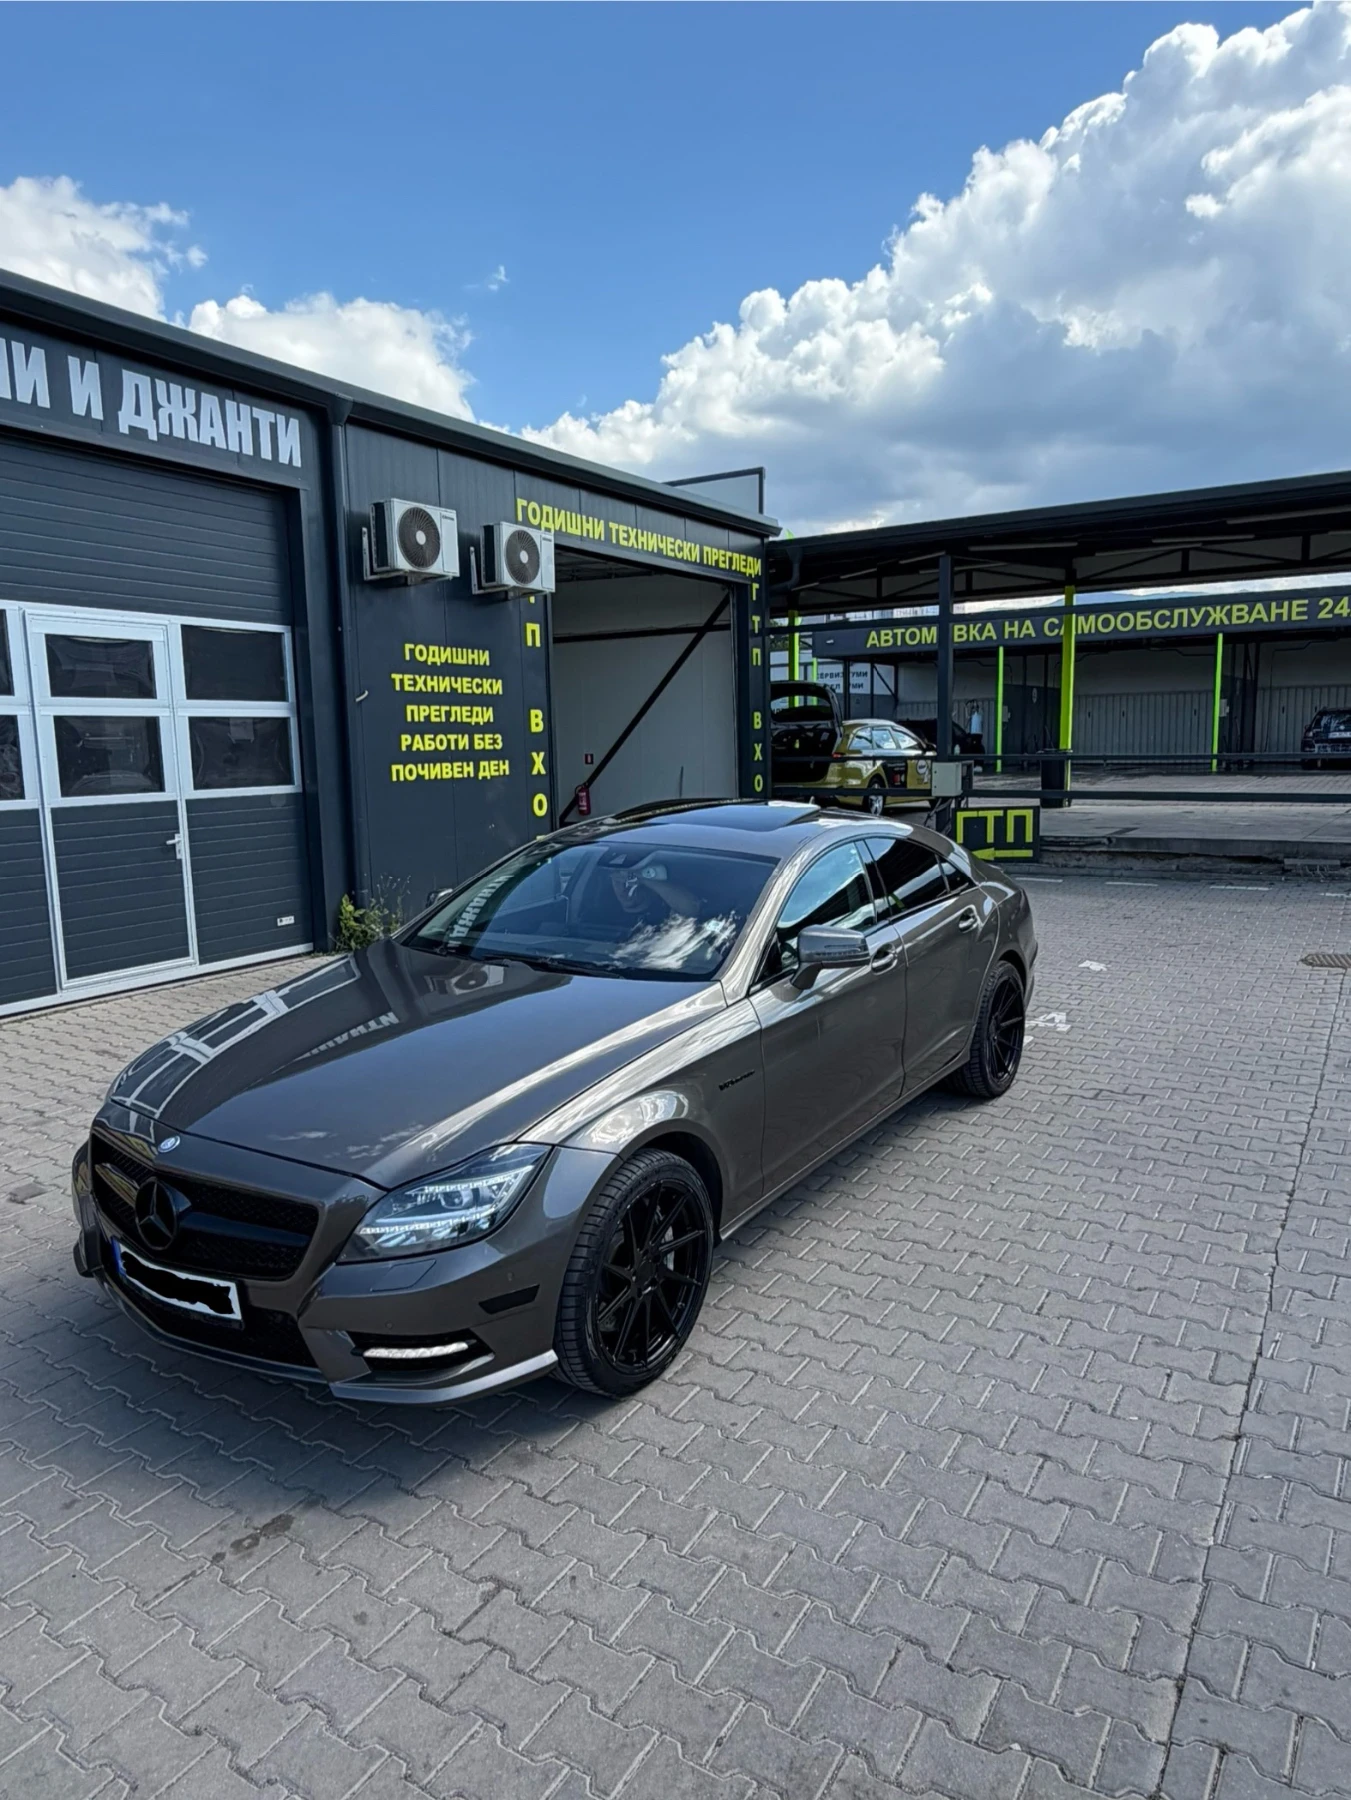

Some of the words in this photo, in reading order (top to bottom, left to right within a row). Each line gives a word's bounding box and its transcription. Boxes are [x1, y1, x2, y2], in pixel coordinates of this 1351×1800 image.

[67, 355, 104, 420] И
[118, 369, 302, 468] ДЖАНТИ
[516, 498, 605, 541] ГОДИШНИ
[608, 522, 700, 563] ТЕХНИЧЕСКИ
[703, 546, 762, 578] ПРЕГЛЕДИ
[866, 622, 997, 648] АВТОМВКА
[1004, 619, 1036, 639] НА
[404, 643, 490, 666] ГОДИШНИ
[391, 673, 503, 695] ТЕХНИЧЕСКИ
[406, 704, 494, 725] ПРЕГЛЕДИ
[401, 734, 469, 751] РАБОТИ
[473, 733, 503, 750] БЕЗ
[391, 761, 474, 782] ПОЧИВЕН
[478, 759, 510, 780] ДЕН
[957, 809, 1034, 844] ГТП
